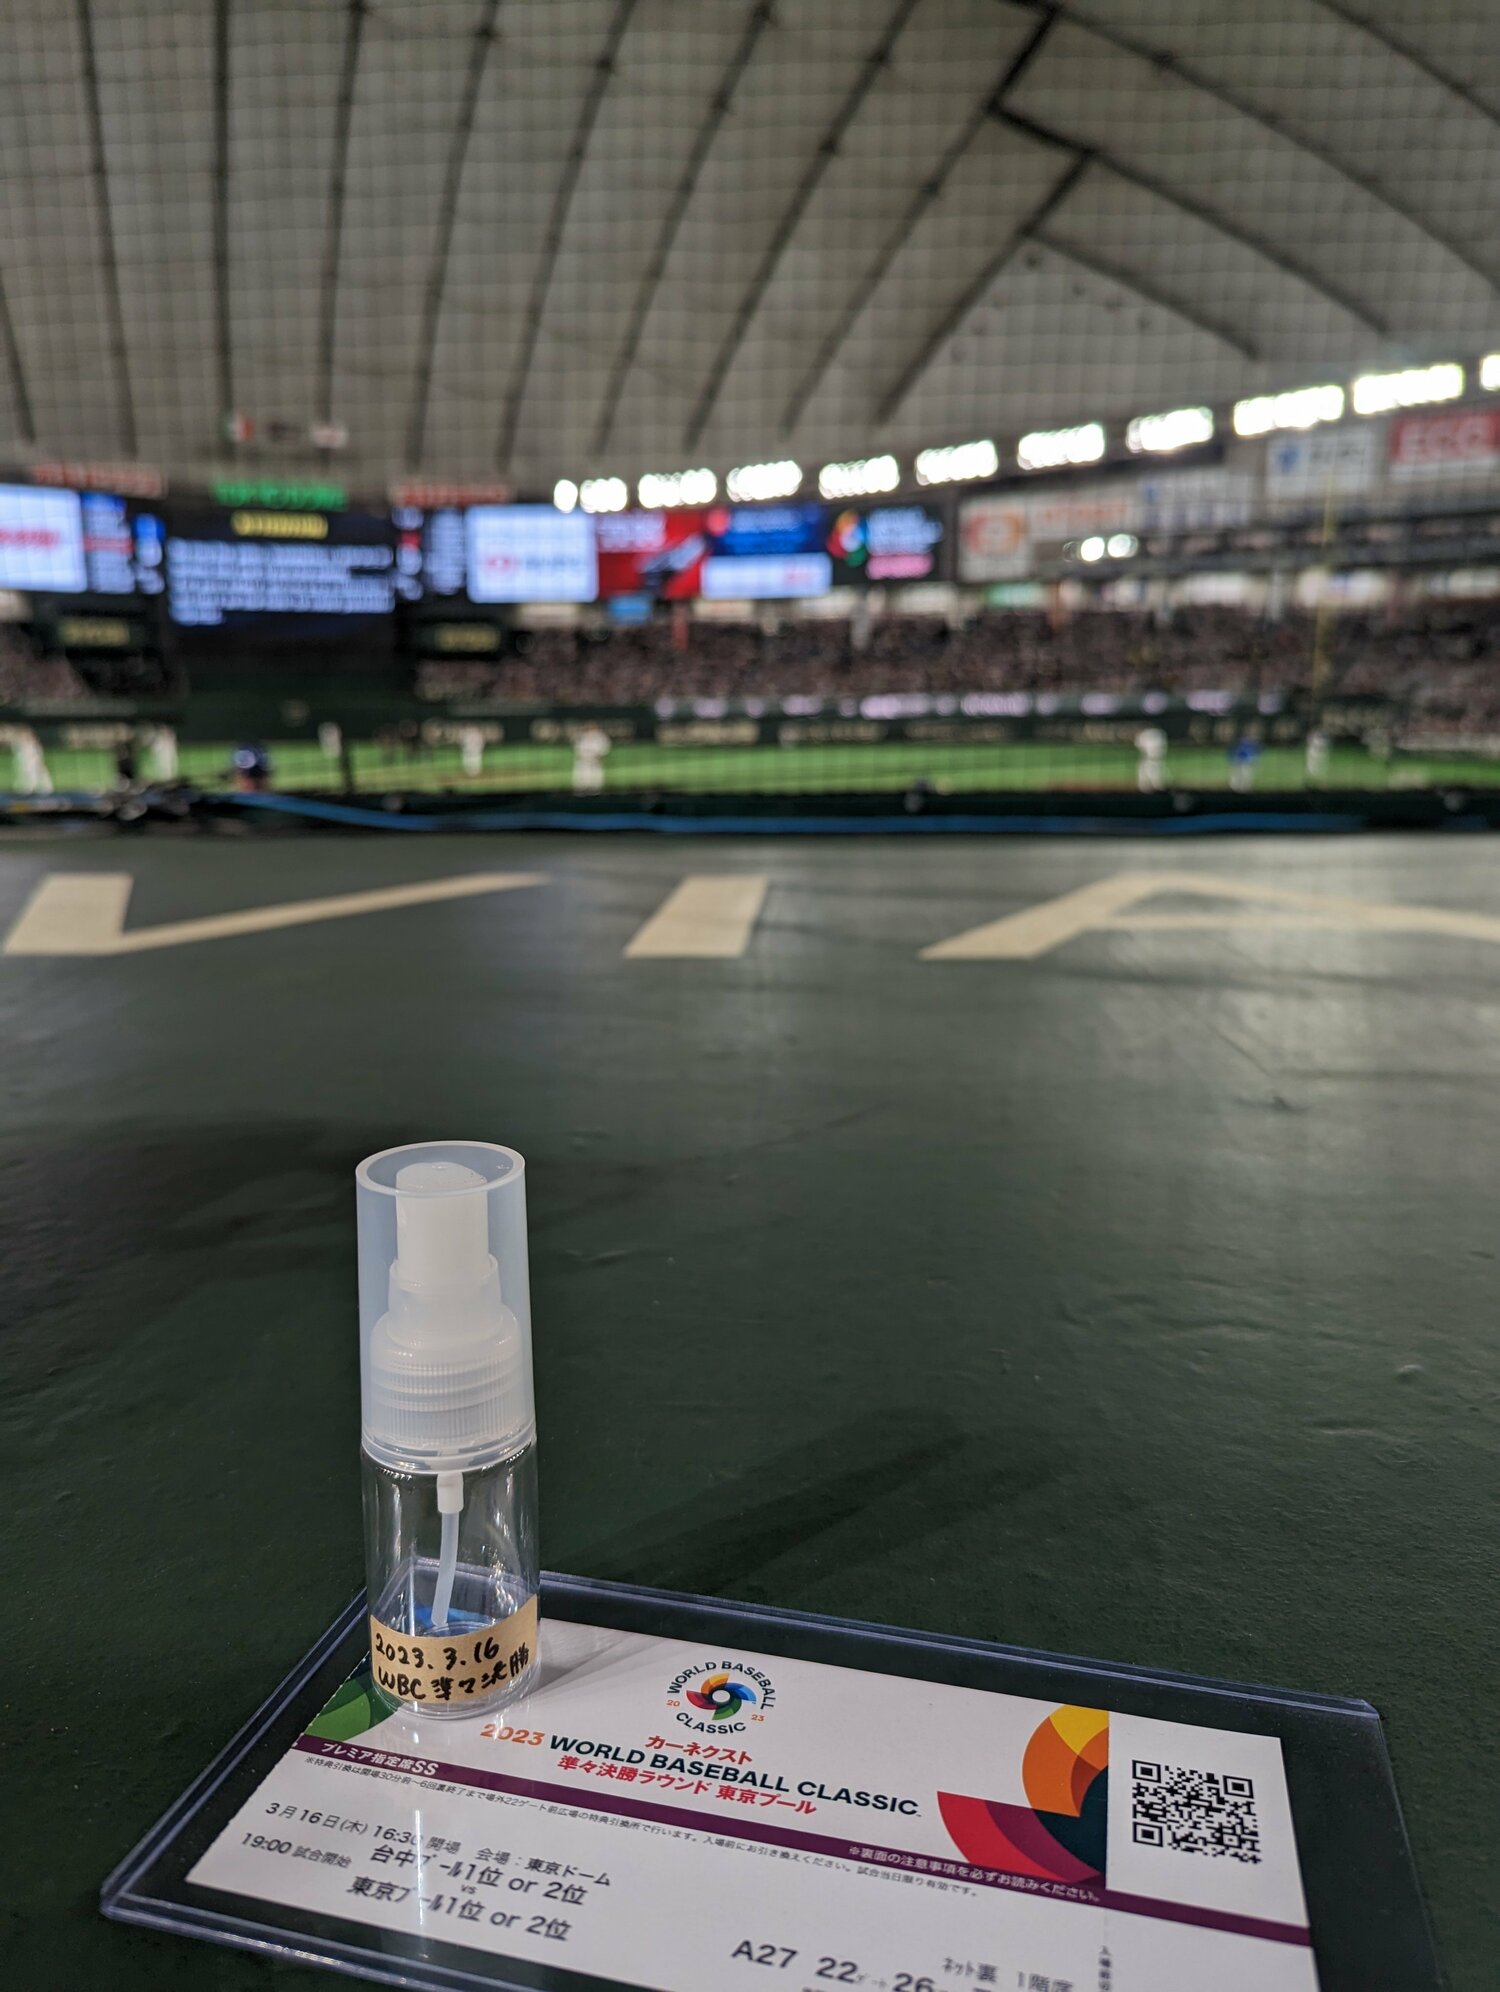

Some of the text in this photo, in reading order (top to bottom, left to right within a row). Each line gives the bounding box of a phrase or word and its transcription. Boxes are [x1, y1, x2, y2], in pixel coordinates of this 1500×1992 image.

[378, 1666, 426, 1700] WBC
[667, 1660, 777, 1710] WORLD BASEBALL
[666, 1699, 766, 1723] 20 23
[675, 1711, 747, 1735] CLASSIC
[321, 1742, 440, 1777] プレミア指定席SS
[644, 1735, 753, 1766] カーネクスト
[479, 1722, 919, 1816] 2023 WORLD BASEBALL CLASSIC
[557, 1755, 817, 1816] 準々決勝ラウンド 東京プール
[241, 1833, 292, 1855] 19:00
[508, 1877, 540, 1894] or
[542, 1881, 588, 1907] 2位
[489, 1910, 521, 1929] or
[525, 1915, 573, 1942] 2位
[731, 1939, 798, 1969] A27
[893, 1972, 936, 1992] 26
